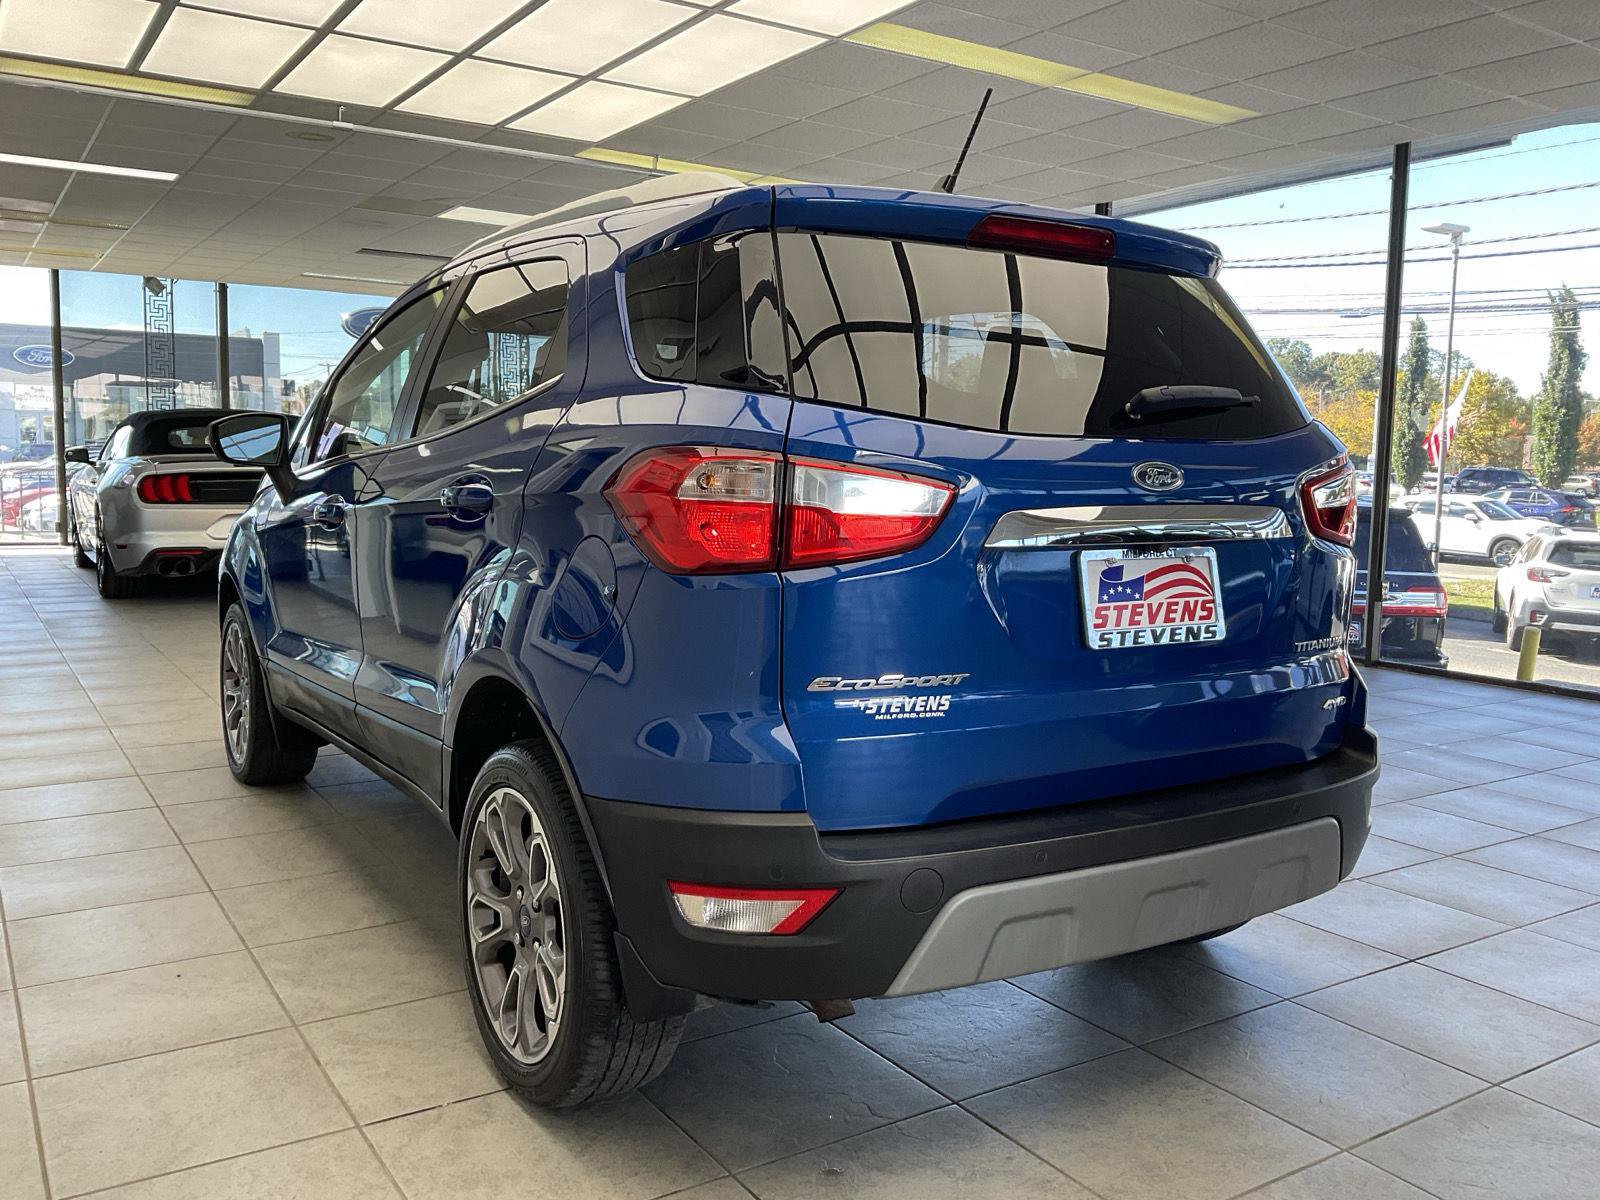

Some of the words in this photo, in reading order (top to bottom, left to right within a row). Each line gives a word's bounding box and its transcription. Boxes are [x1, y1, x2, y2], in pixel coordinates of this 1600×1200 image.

[27, 349, 58, 363] For
[1145, 467, 1172, 485] Ford
[1093, 599, 1215, 629] STEVENS
[1098, 625, 1218, 648] STEVENS
[865, 695, 951, 714] STEVENS
